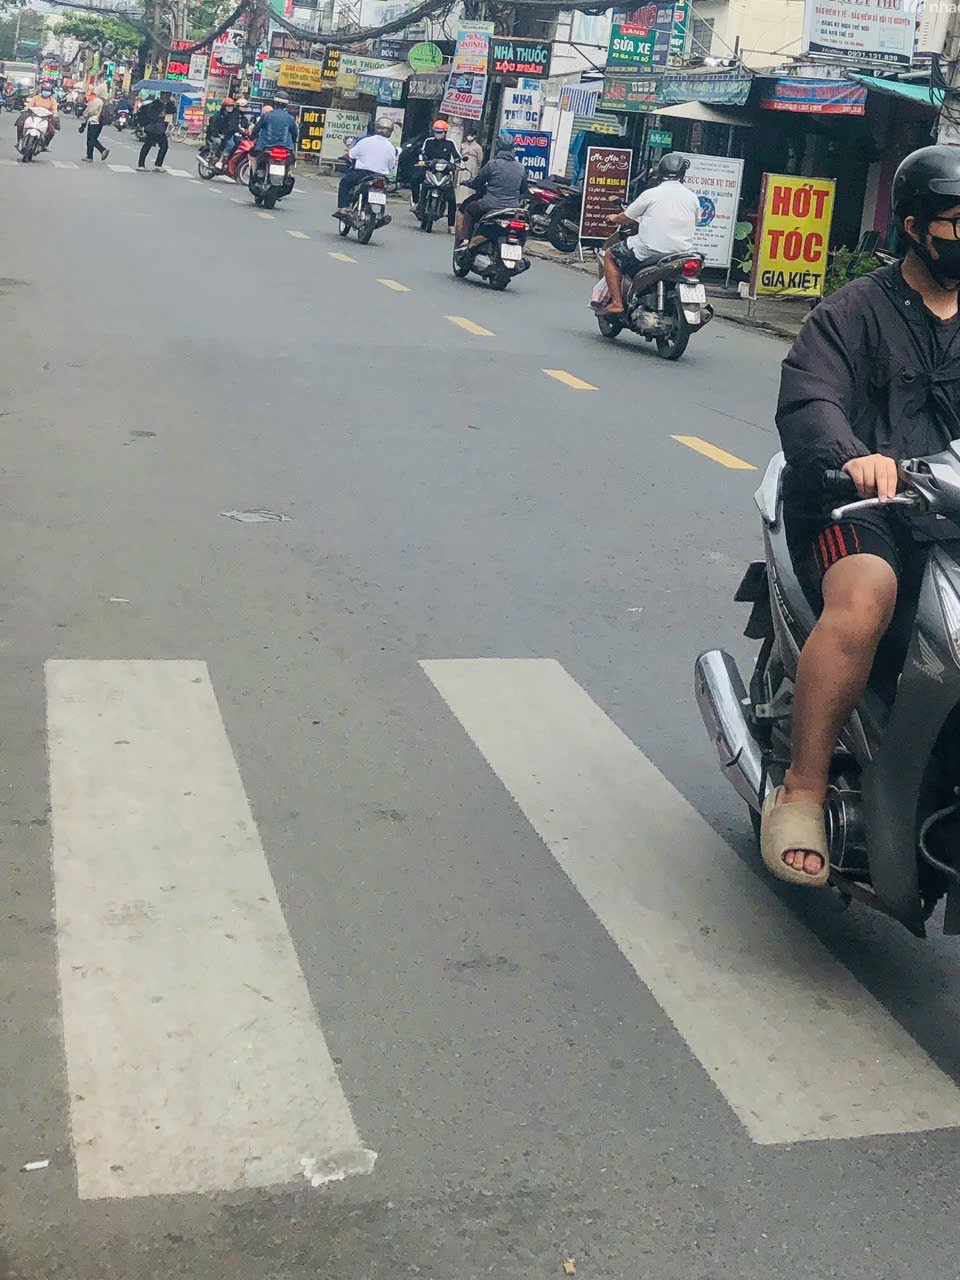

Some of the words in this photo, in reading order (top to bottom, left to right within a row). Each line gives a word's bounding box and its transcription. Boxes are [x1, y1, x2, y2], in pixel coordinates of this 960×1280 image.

[494, 42, 515, 61] NHÀ
[516, 44, 548, 64] THUỐC
[612, 35, 635, 52] SỬA
[637, 41, 651, 55] XE
[303, 111, 319, 123] HỚT
[345, 112, 360, 122] NHÀ
[352, 122, 366, 132] TÂY
[772, 183, 830, 221] HỚT
[767, 226, 824, 264] TÓC
[761, 270, 786, 289] GIA
[788, 269, 822, 291] KIỆT
